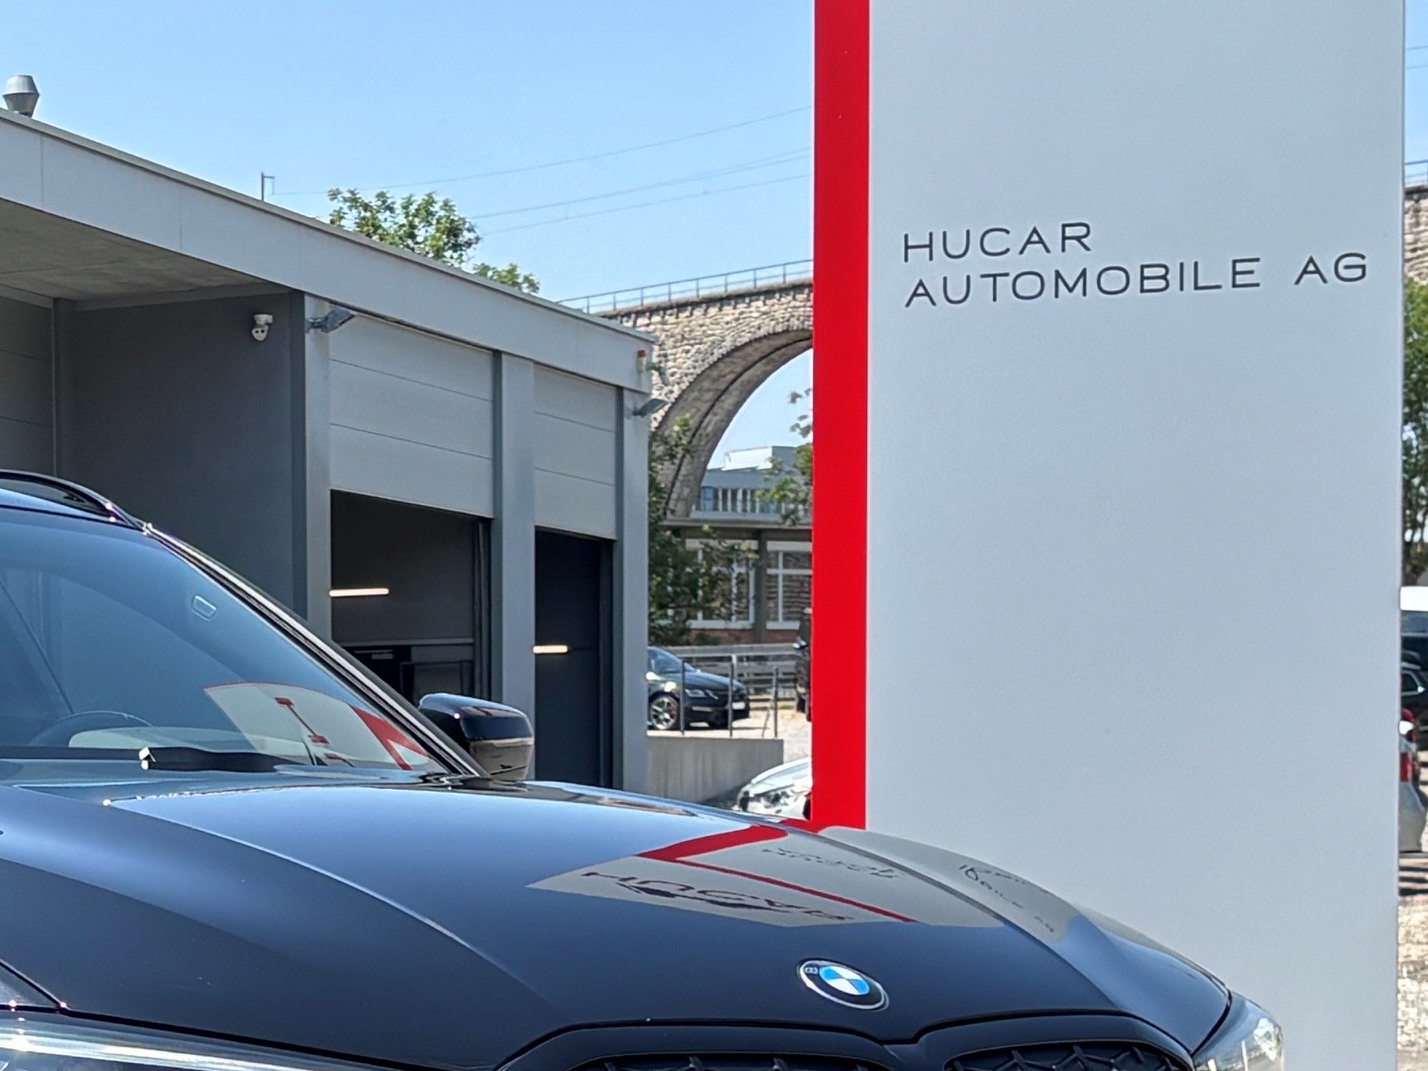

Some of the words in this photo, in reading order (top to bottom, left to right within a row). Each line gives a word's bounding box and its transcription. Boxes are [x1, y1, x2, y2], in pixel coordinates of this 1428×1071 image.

[903, 222, 1092, 263] HUCAR
[905, 257, 1262, 308] AUTOMOBILE
[1294, 252, 1367, 286] AG
